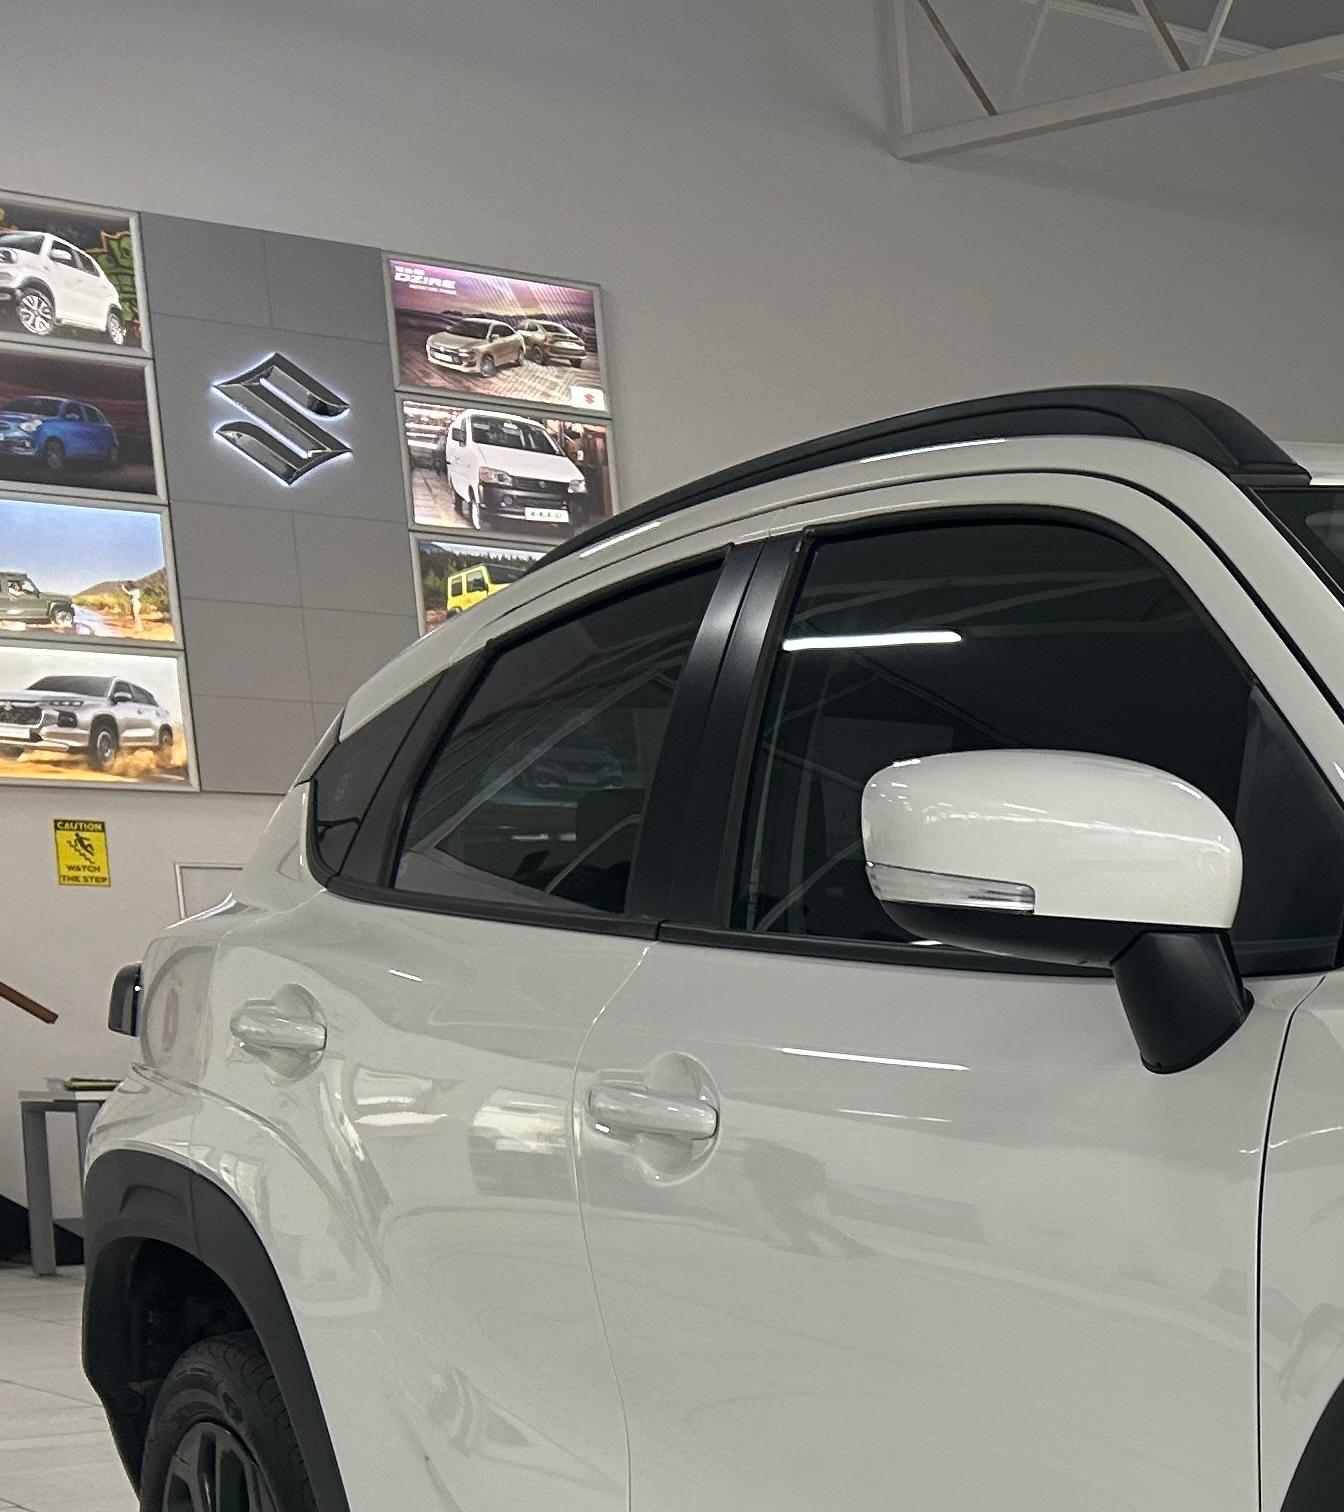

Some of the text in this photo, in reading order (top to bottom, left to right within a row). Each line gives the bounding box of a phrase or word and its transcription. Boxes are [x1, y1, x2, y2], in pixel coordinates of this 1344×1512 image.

[57, 821, 103, 831] CAUTION
[65, 863, 101, 873] WATCH
[61, 874, 107, 884] THE STEP
